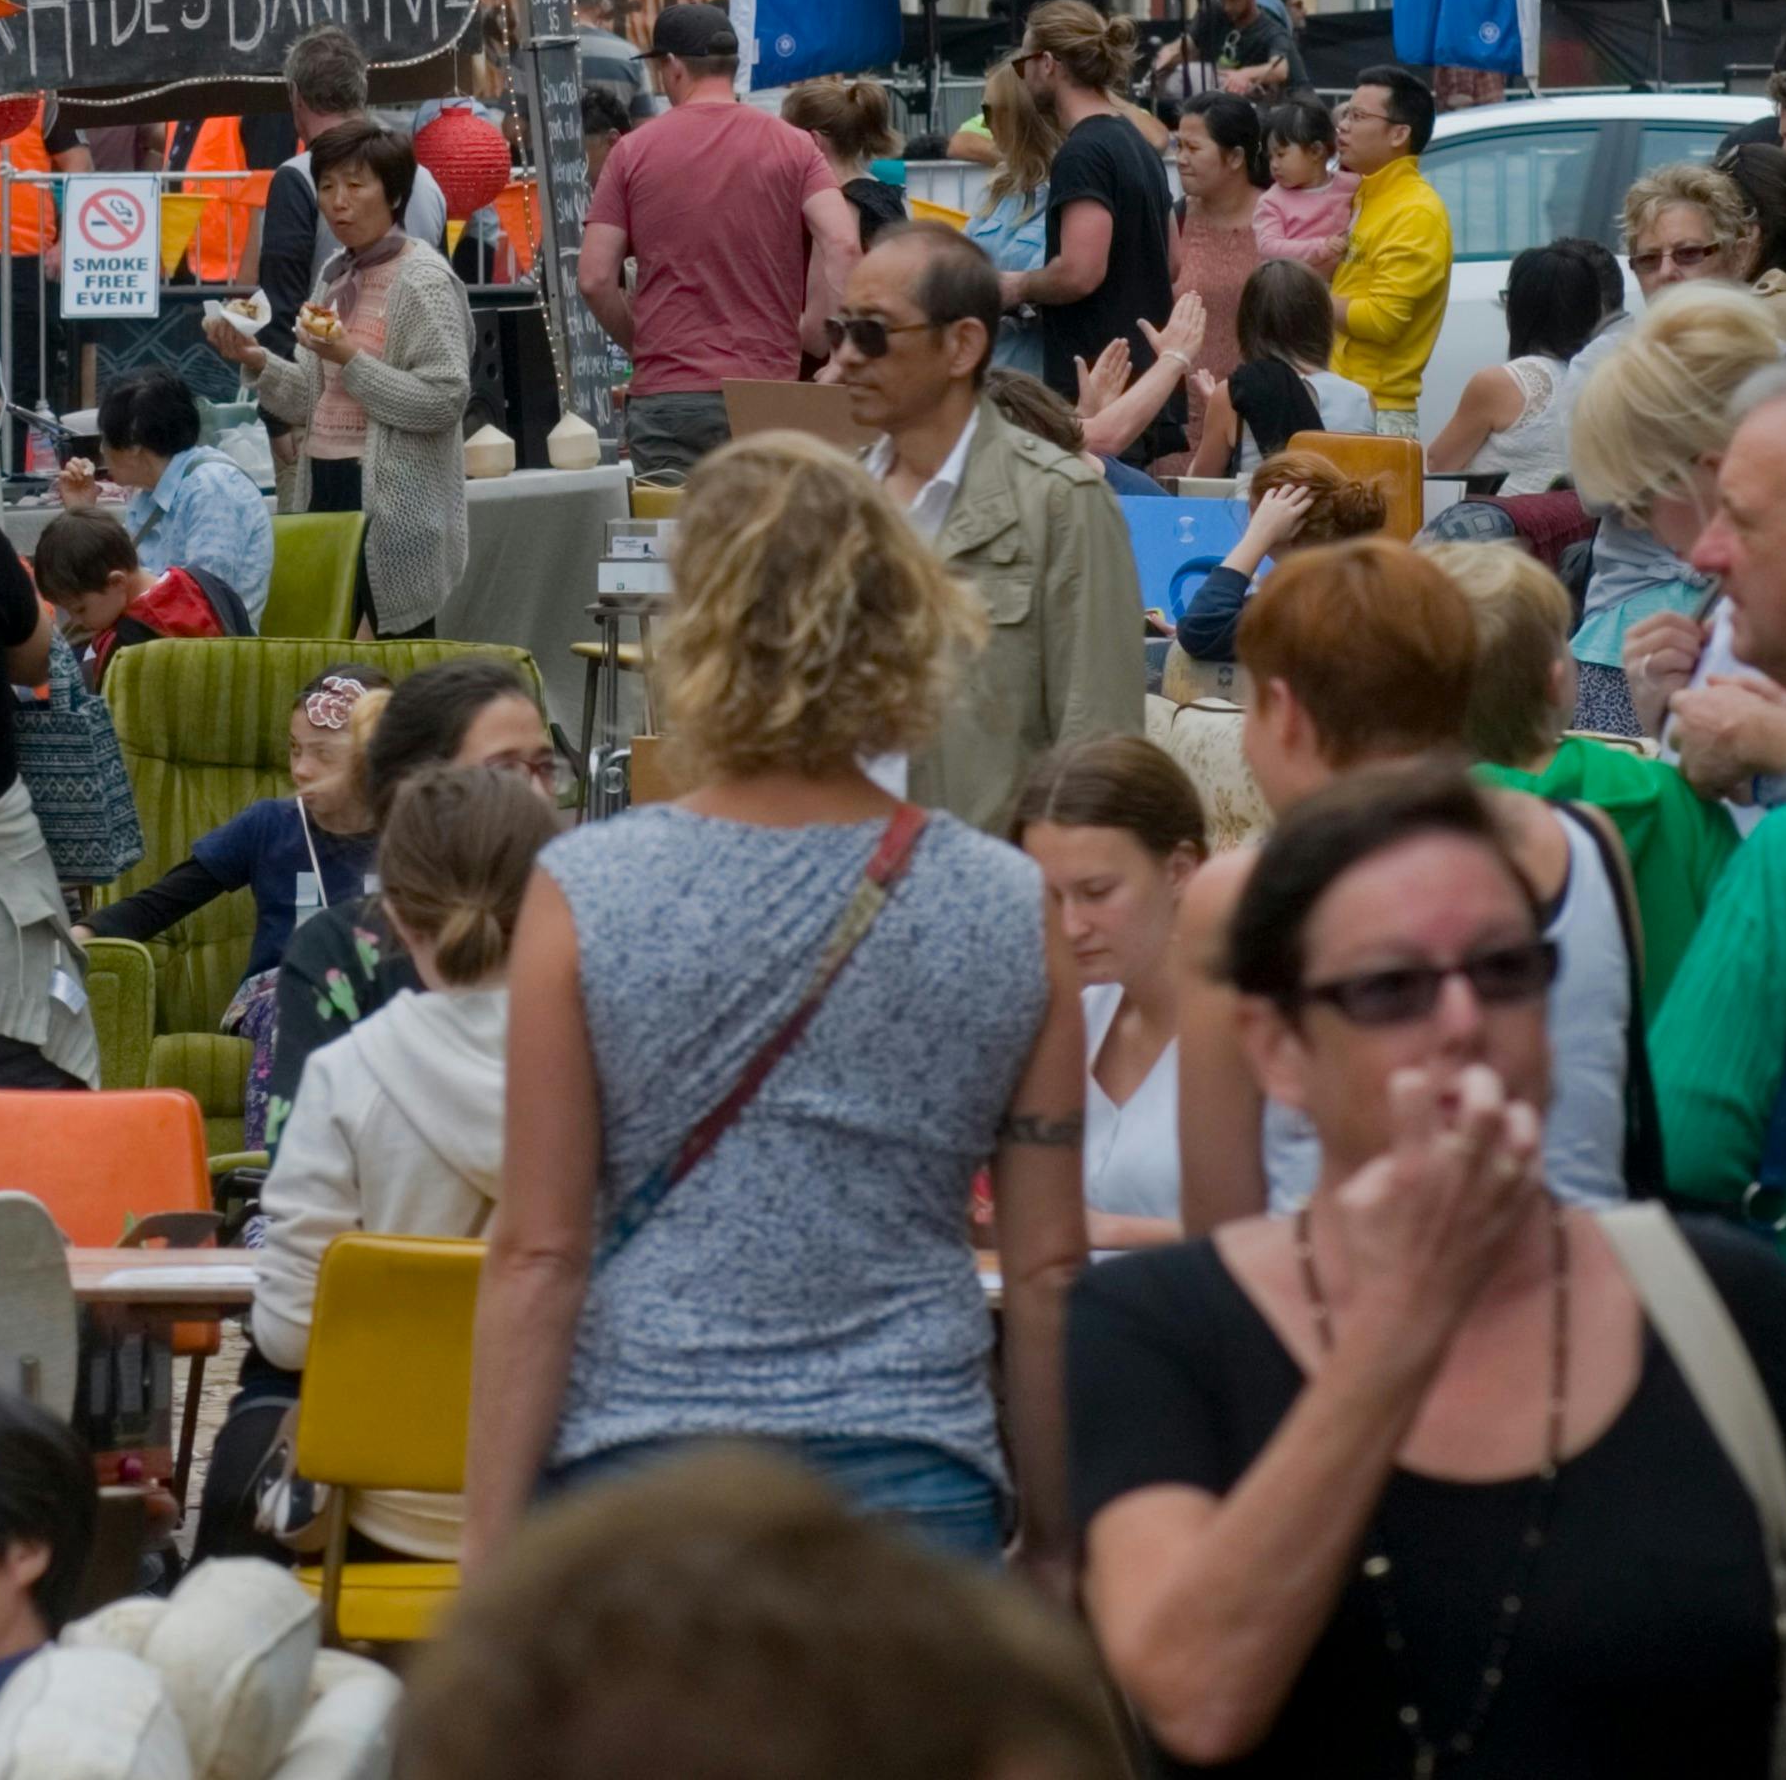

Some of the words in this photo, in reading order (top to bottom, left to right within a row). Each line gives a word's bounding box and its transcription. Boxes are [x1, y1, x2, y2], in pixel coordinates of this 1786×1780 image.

[73, 257, 149, 271] SMOKE
[85, 274, 139, 288] FREE
[76, 291, 148, 305] EVENT
